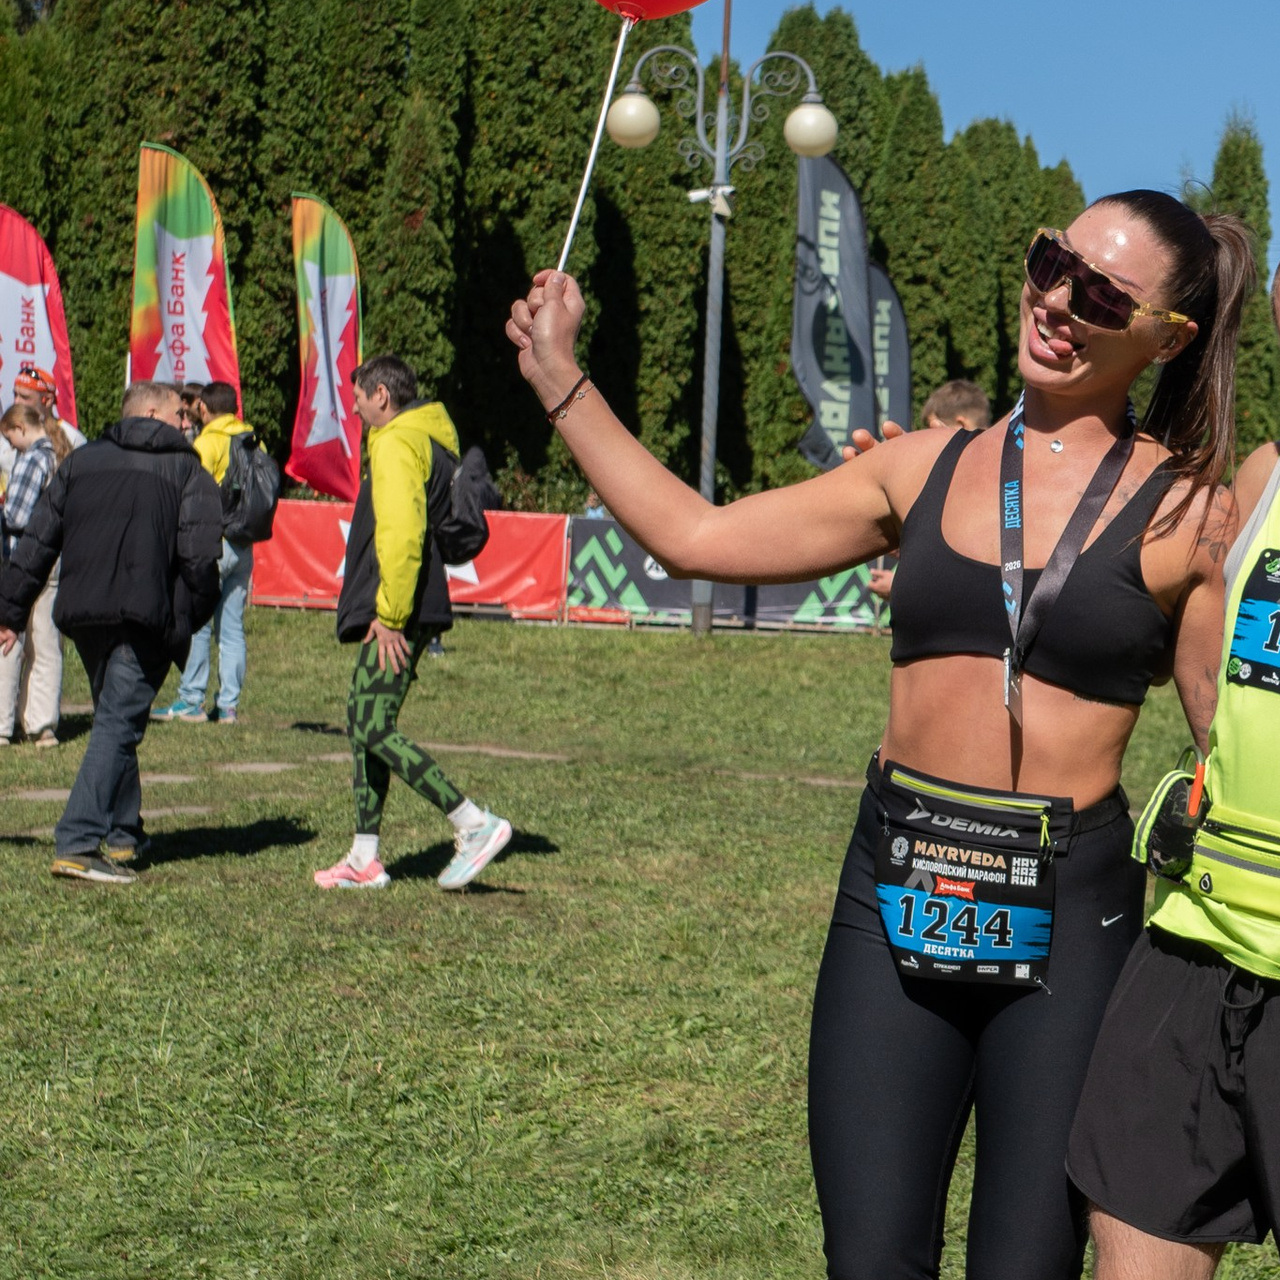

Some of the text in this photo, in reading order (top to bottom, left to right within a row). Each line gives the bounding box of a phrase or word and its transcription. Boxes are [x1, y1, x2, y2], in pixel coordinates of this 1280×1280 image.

[168, 249, 186, 316] Банк
[15, 296, 35, 355] Банк
[1004, 480, 1021, 529] ДЕСЯТКА
[931, 815, 1019, 838] DEMIX
[914, 840, 1007, 869] MAYRVEDA
[912, 857, 967, 876] КИСЛОВОДСКИЙ
[967, 868, 1006, 884] МАРАФОН
[1011, 875, 1037, 887] RUN
[897, 893, 1014, 948] 1244
[923, 943, 975, 959] ДЕСЯТКА
